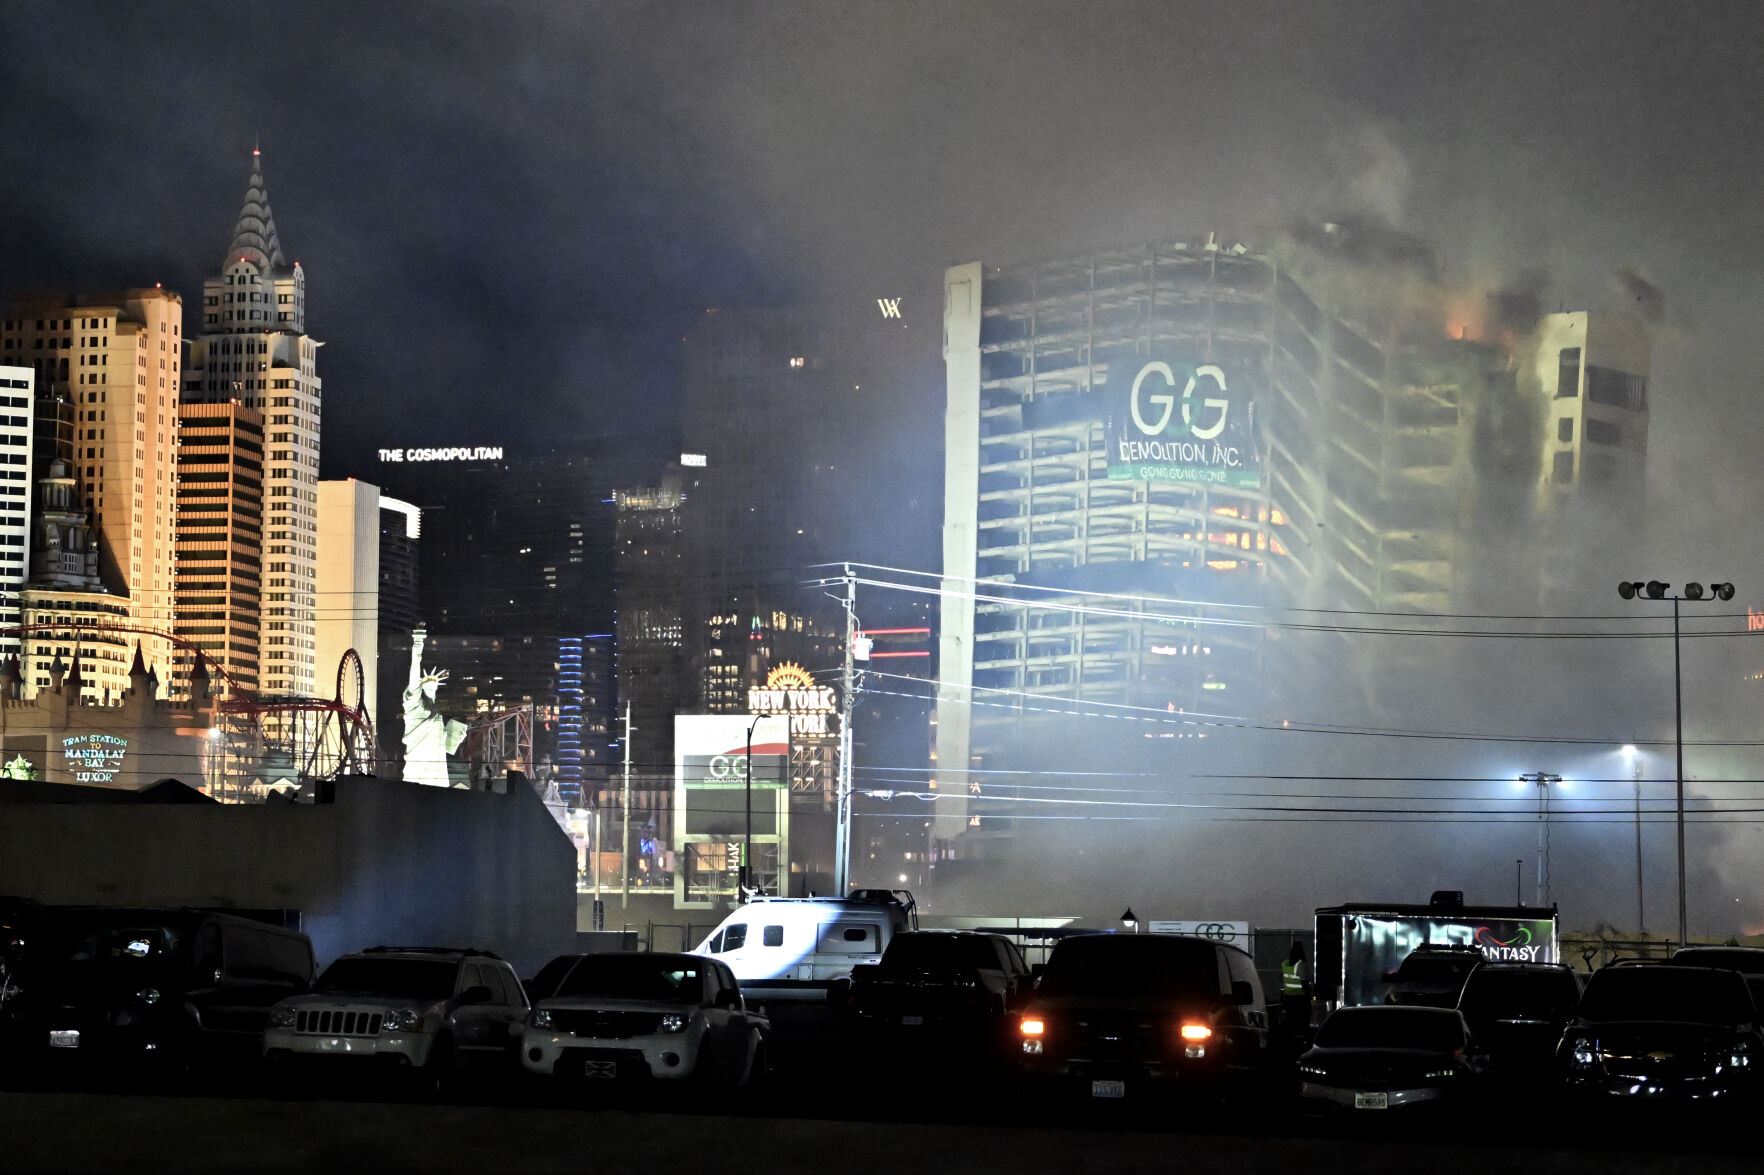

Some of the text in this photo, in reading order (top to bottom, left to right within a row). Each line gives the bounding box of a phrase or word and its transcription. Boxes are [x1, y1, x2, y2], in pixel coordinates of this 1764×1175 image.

[379, 446, 503, 462] THE COSMOPOLITAN
[1211, 443, 1242, 467] INC.
[748, 690, 832, 711] NEW YORK
[62, 734, 128, 747] TRAM STATION
[65, 749, 126, 759] MANDALAY
[84, 758, 106, 768] BAY
[76, 772, 113, 782] LUXOR
